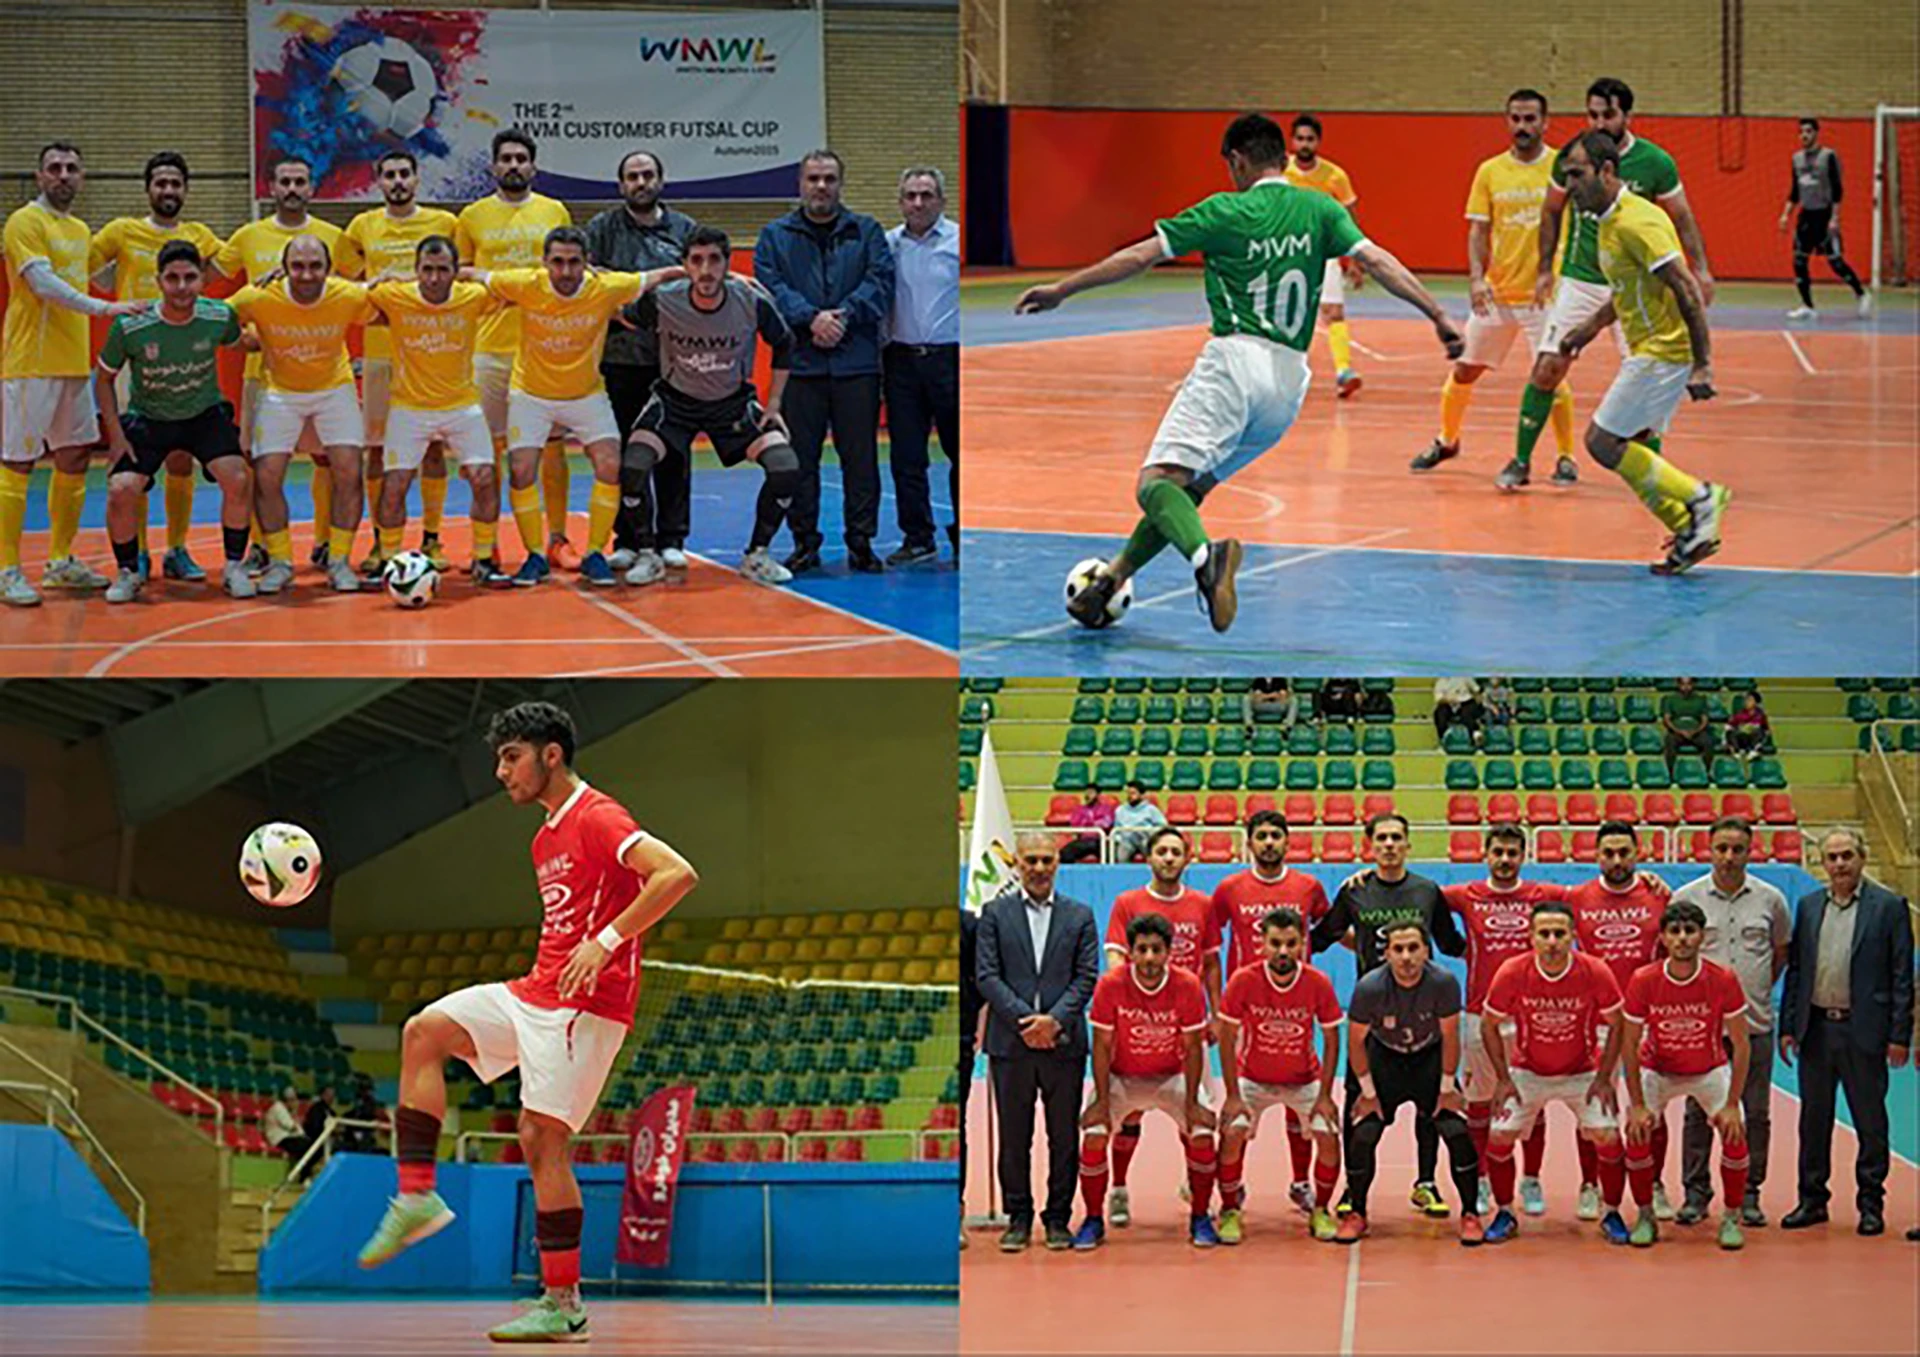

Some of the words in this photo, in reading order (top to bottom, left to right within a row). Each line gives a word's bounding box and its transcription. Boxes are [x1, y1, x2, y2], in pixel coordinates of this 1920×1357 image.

[639, 37, 777, 63] WMWL
[514, 103, 547, 118] THE
[513, 122, 559, 138] MVM
[564, 121, 665, 138] CUSTOMER
[670, 121, 738, 138] FUTSAL
[741, 121, 779, 138] CUP
[1247, 233, 1311, 260] MVM
[1246, 269, 1308, 340] 10
[1580, 908, 1651, 921] WMWL
